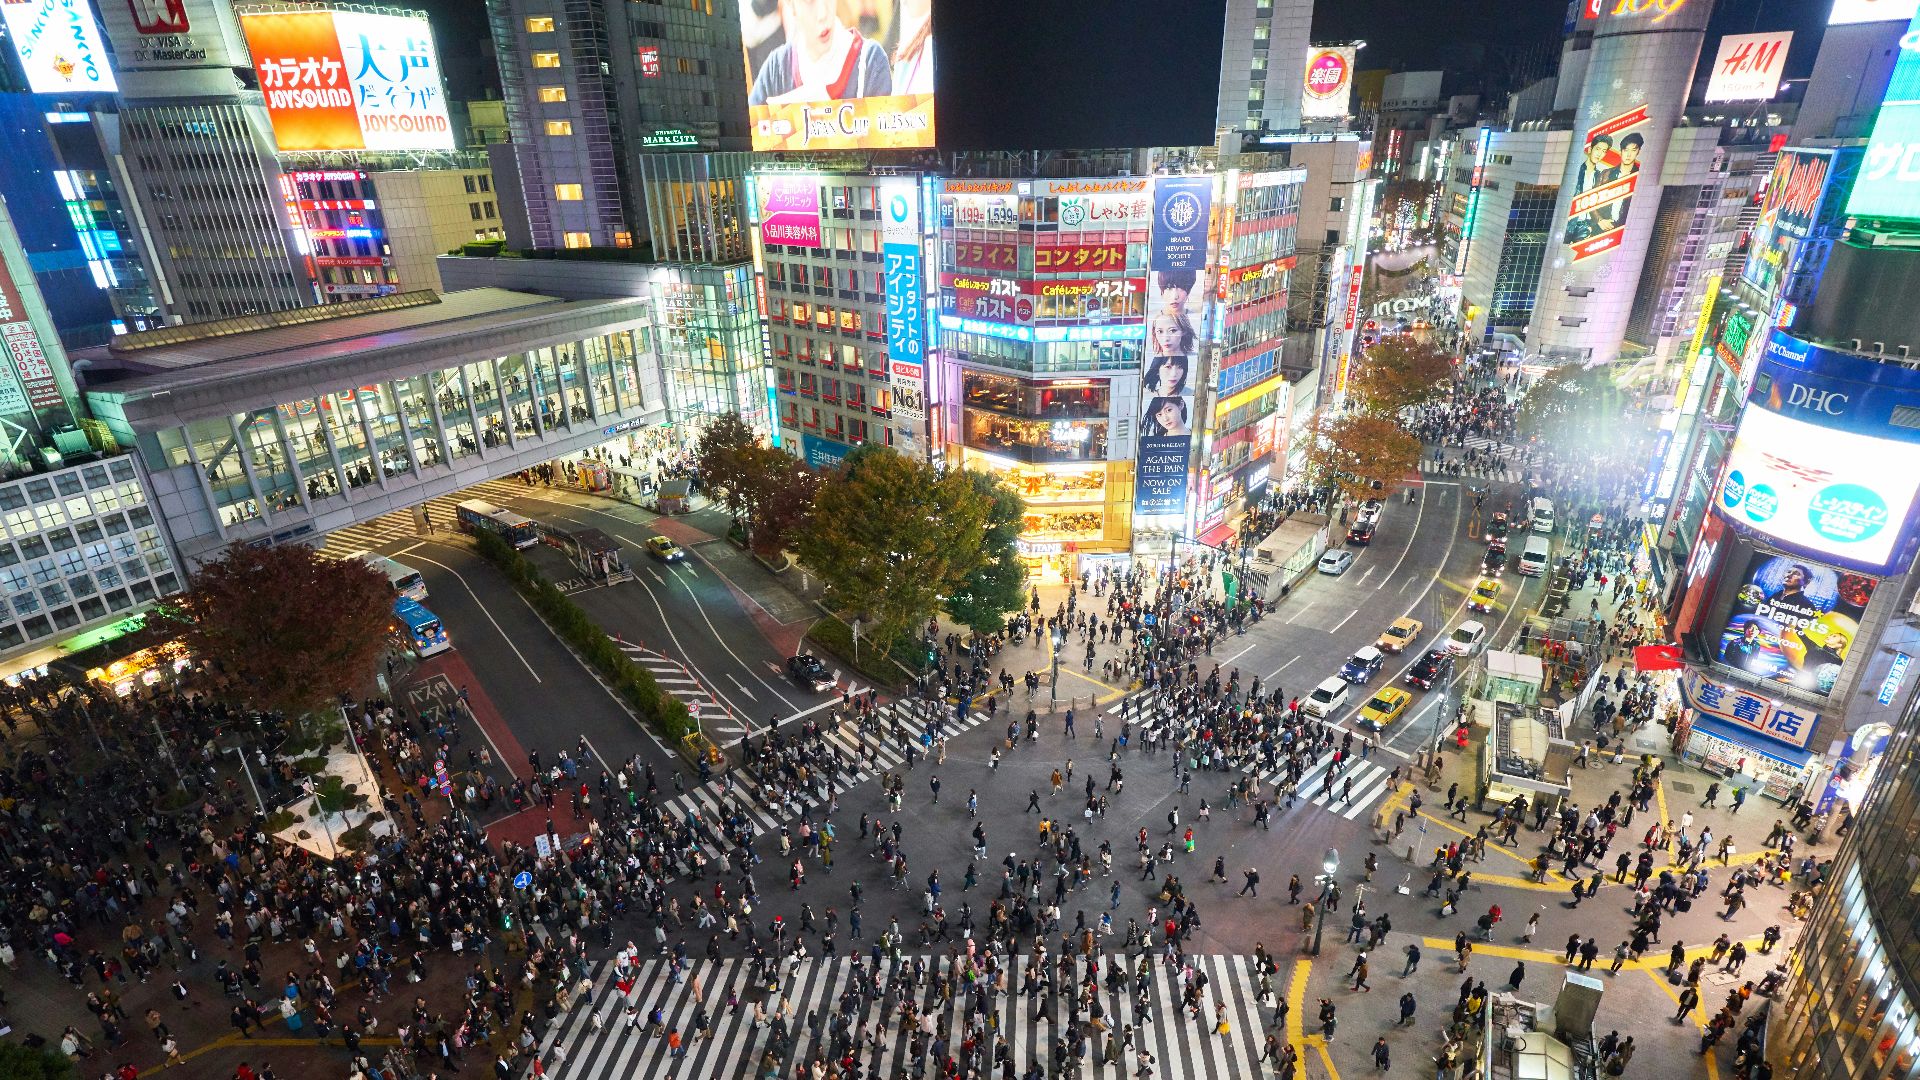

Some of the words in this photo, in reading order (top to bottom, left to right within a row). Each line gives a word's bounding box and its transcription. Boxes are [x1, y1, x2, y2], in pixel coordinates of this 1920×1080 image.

[158, 37, 182, 47] VISA
[152, 49, 206, 61] MasterCard
[346, 33, 430, 83] 大声
[1721, 40, 1782, 76] H&M
[260, 56, 342, 88] カラオケ
[1309, 68, 1342, 84] 楽園
[268, 88, 351, 109] JOYSOUND
[364, 114, 447, 133] JOYSOUND
[839, 105, 870, 135] CUP
[643, 136, 671, 144] MARK
[296, 172, 322, 182] カラオケ
[944, 181, 1013, 194] しゃぶしゃぶバイキング
[1049, 181, 1148, 194] しゃぶしゃぶバイキング
[784, 196, 812, 208] クリニック
[942, 205, 953, 216] 9F
[1090, 200, 1147, 220] しゃぶ葉
[770, 224, 818, 241] 品川美容外科
[1036, 247, 1124, 266] コンタクト
[990, 279, 1020, 297] ガスト
[1095, 281, 1136, 297] ガスト
[664, 299, 691, 307] ARK
[887, 253, 905, 353] アイシティ
[904, 255, 919, 355] コンタクトの
[943, 295, 957, 308] 7F
[976, 297, 1011, 319] ガスト
[1347, 291, 1359, 324] TaxFree
[1778, 345, 1807, 362] Channel
[892, 385, 924, 412] No.1
[1787, 383, 1849, 415] DHC
[811, 449, 844, 465] 三井住友
[1146, 455, 1183, 463] AGAINST
[1143, 465, 1161, 473] THE
[1163, 465, 1185, 473] PAIN
[1142, 479, 1166, 487] NOW
[1758, 534, 1775, 545] DHC
[1770, 598, 1814, 617] teamLab
[1754, 603, 1829, 634] Planets
[1764, 634, 1803, 650] TOYOSU
[1685, 667, 1805, 737] 堂書店
